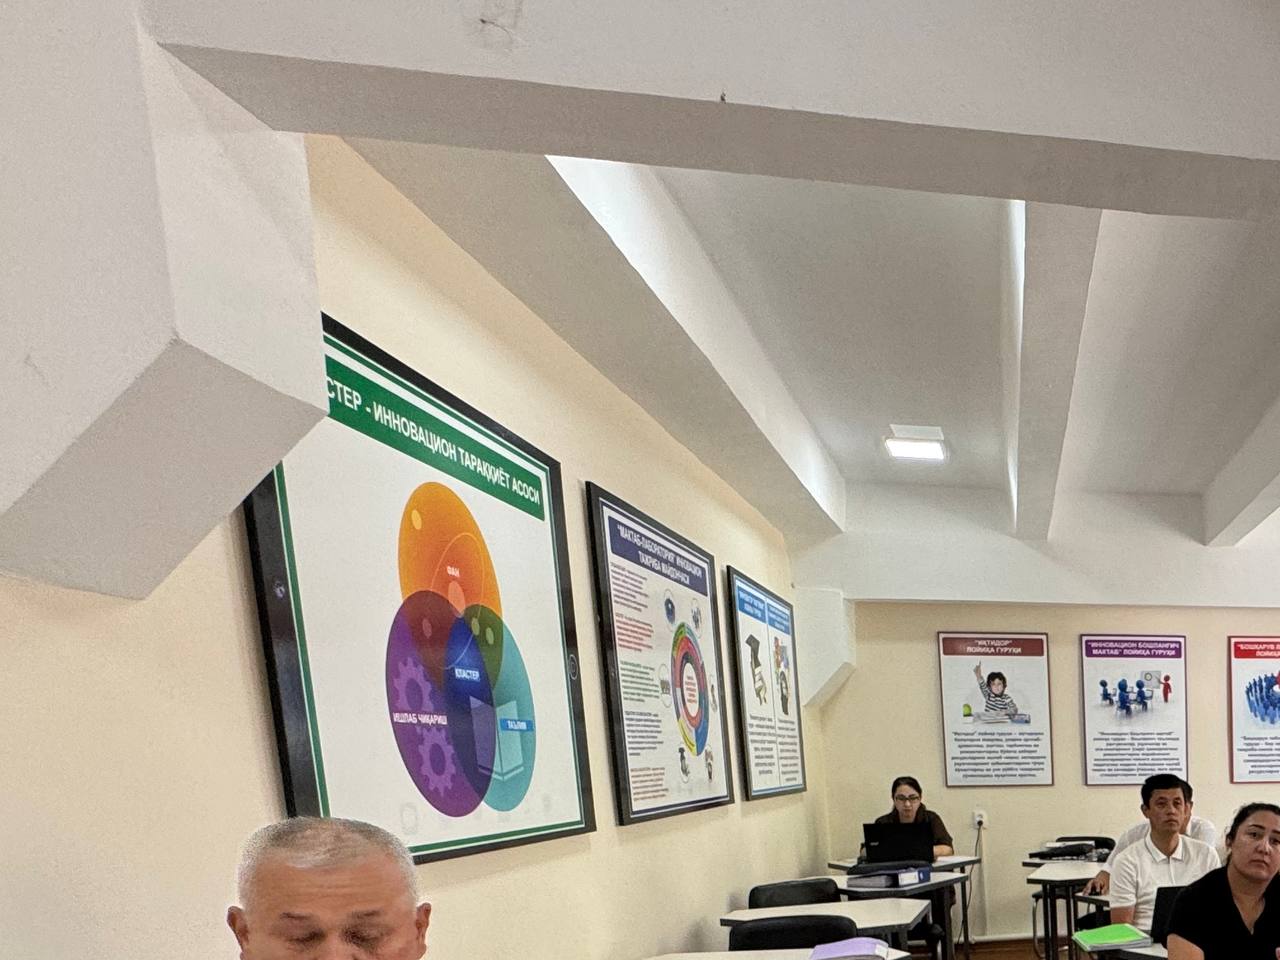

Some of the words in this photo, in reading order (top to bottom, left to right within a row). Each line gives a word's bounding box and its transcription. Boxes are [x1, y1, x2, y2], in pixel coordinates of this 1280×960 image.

[373, 401, 457, 461] ИННОВАЦИОН
[512, 477, 540, 506] АСОСИ
[447, 565, 460, 578] ФАН
[455, 668, 480, 680] КЛАСТЕР
[393, 712, 418, 723] ИШЛАБ
